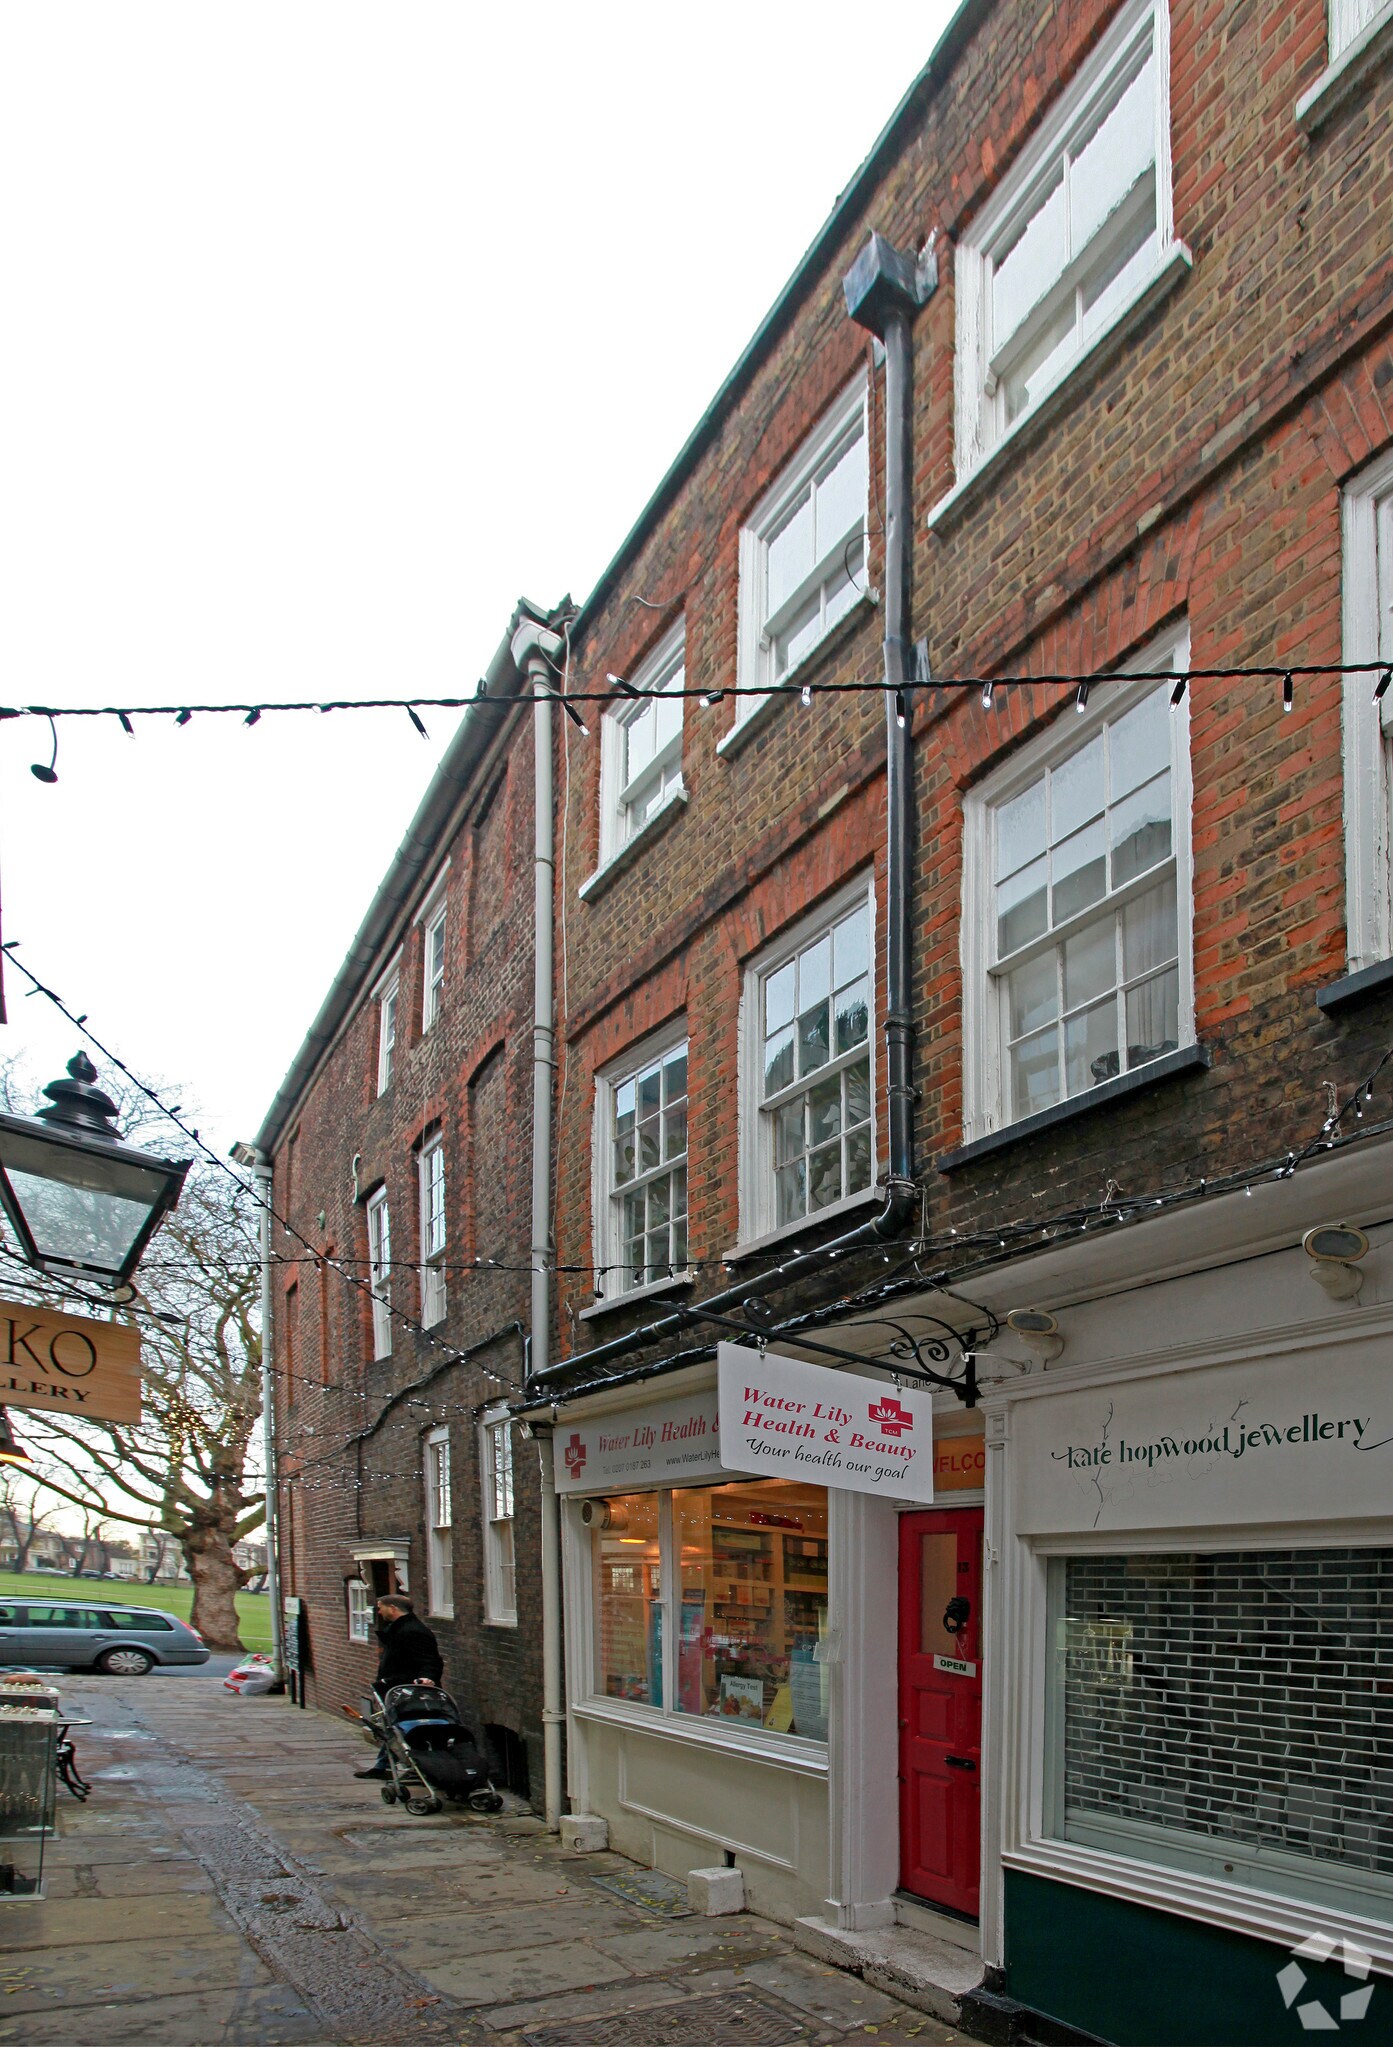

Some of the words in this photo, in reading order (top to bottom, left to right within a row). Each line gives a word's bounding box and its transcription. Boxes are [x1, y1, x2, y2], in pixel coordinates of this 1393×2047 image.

[743, 1387, 806, 1414] Water
[812, 1403, 853, 1427] Lily
[599, 1434, 630, 1453] Water
[632, 1425, 657, 1450] Lily
[660, 1415, 706, 1443] Health
[741, 1411, 816, 1439] Health
[823, 1428, 841, 1444] &
[849, 1432, 917, 1461] Beauty
[884, 1428, 898, 1436] TCM
[746, 1438, 791, 1458] Your
[794, 1445, 842, 1468] health
[846, 1461, 872, 1475] our
[870, 1465, 909, 1482] goal
[1050, 1442, 1112, 1469] kate
[940, 1659, 967, 1672] OPEN
[729, 1680, 746, 1691] Allergy
